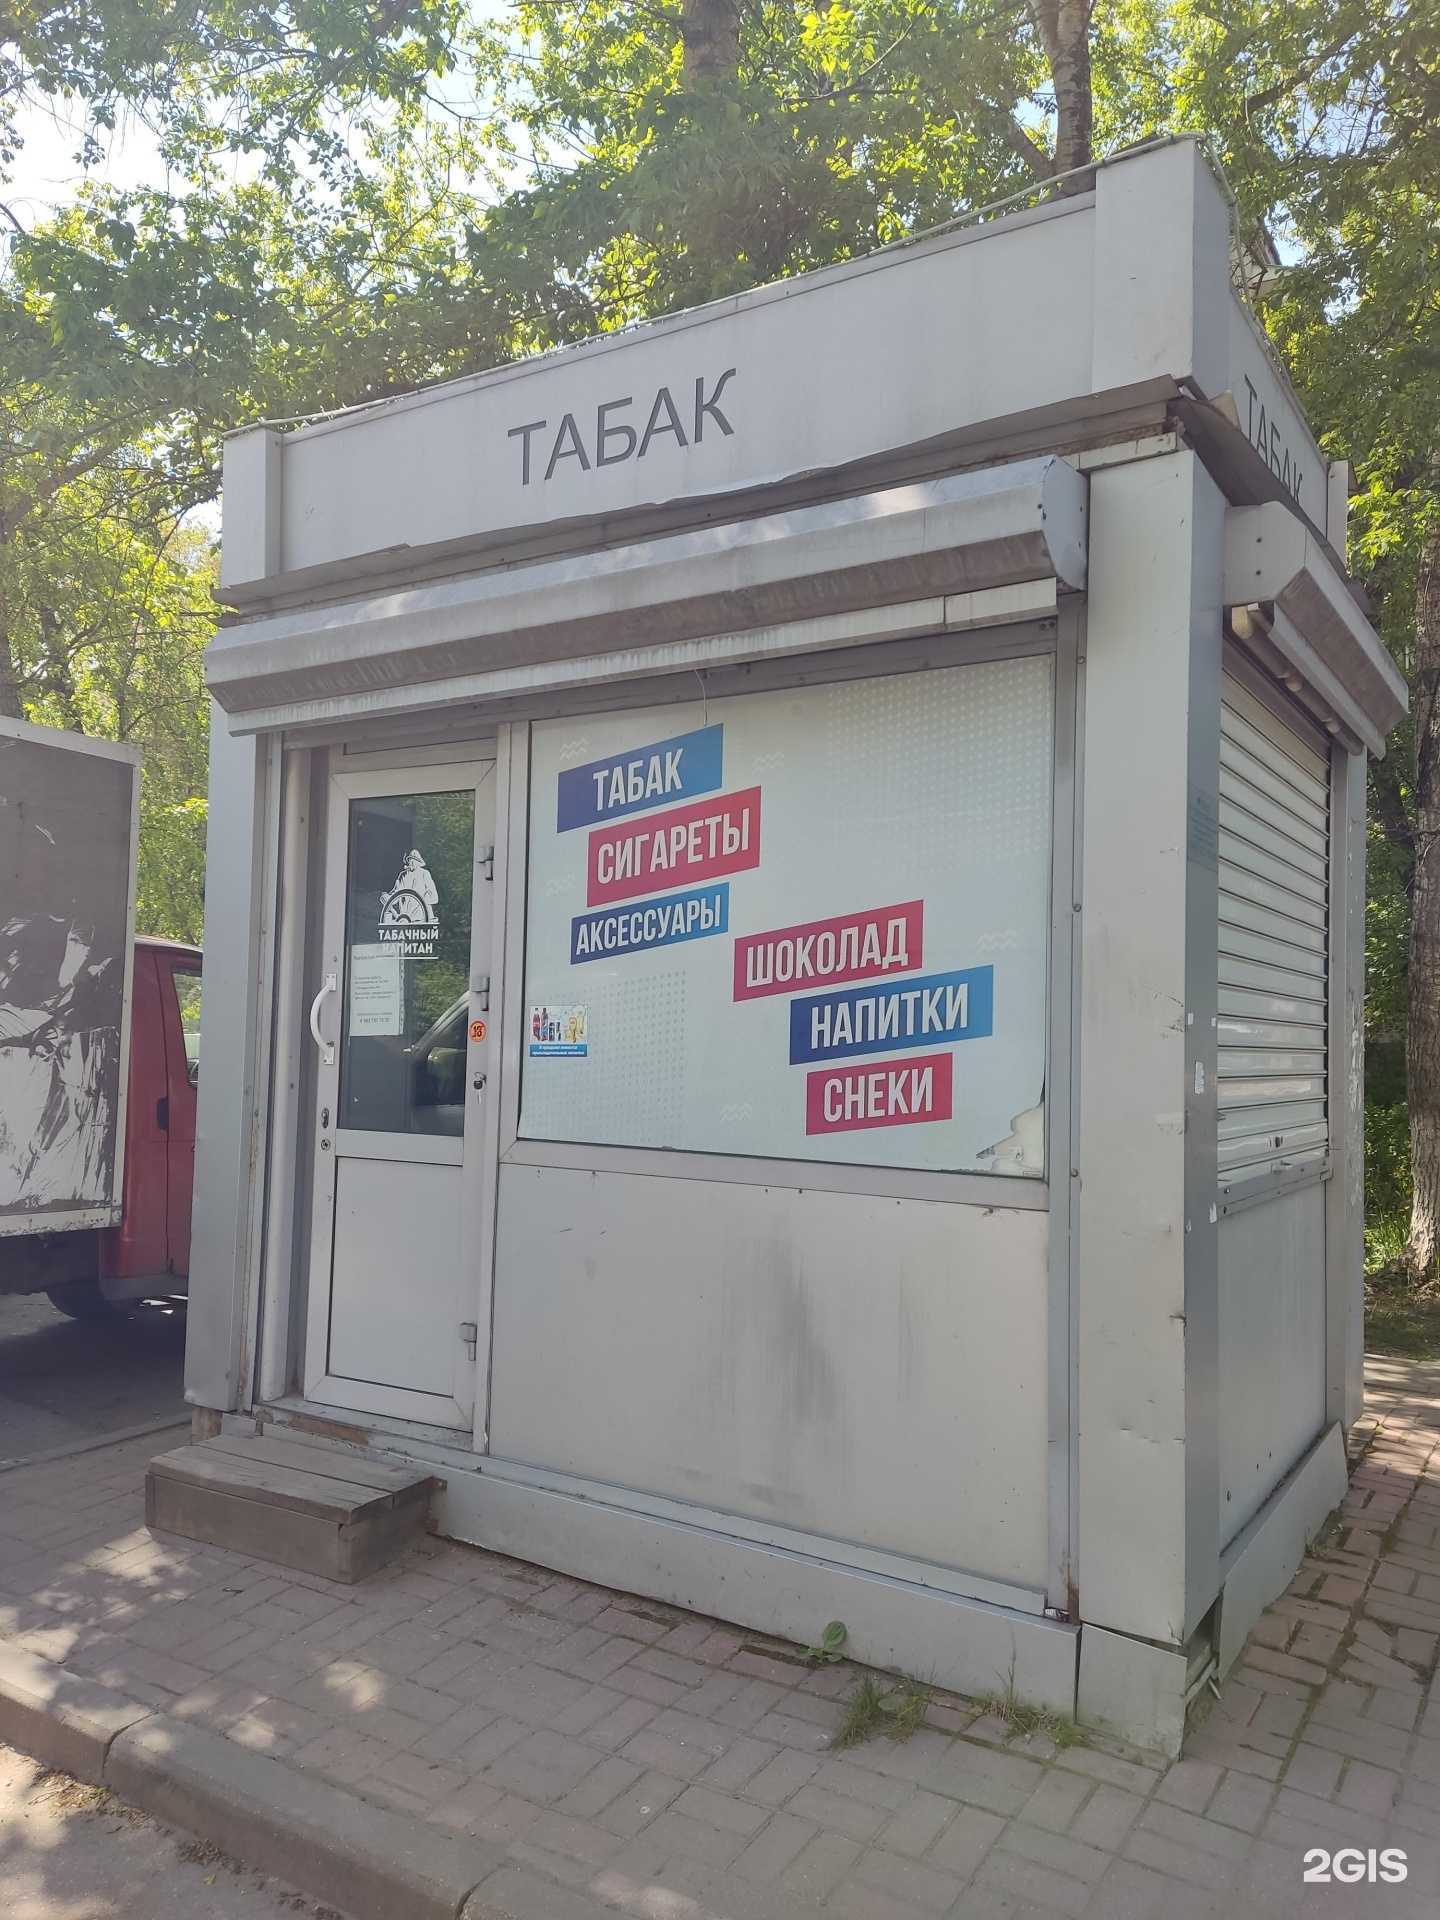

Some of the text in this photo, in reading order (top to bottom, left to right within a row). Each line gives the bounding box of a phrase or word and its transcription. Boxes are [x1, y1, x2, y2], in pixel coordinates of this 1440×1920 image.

[508, 368, 736, 485] ТАБАК
[1244, 374, 1303, 505] ТАБАК
[593, 749, 684, 811] ТАБАК
[597, 808, 750, 885] СИГАРЕТЫ
[378, 926, 439, 940] ТАБАЧНЫЙ
[575, 894, 721, 955] АКСЕССУАРЫ
[746, 917, 909, 987] ШОКОЛАД
[811, 983, 968, 1049] НАПИТКИ
[823, 1067, 933, 1122] СНЕКИ
